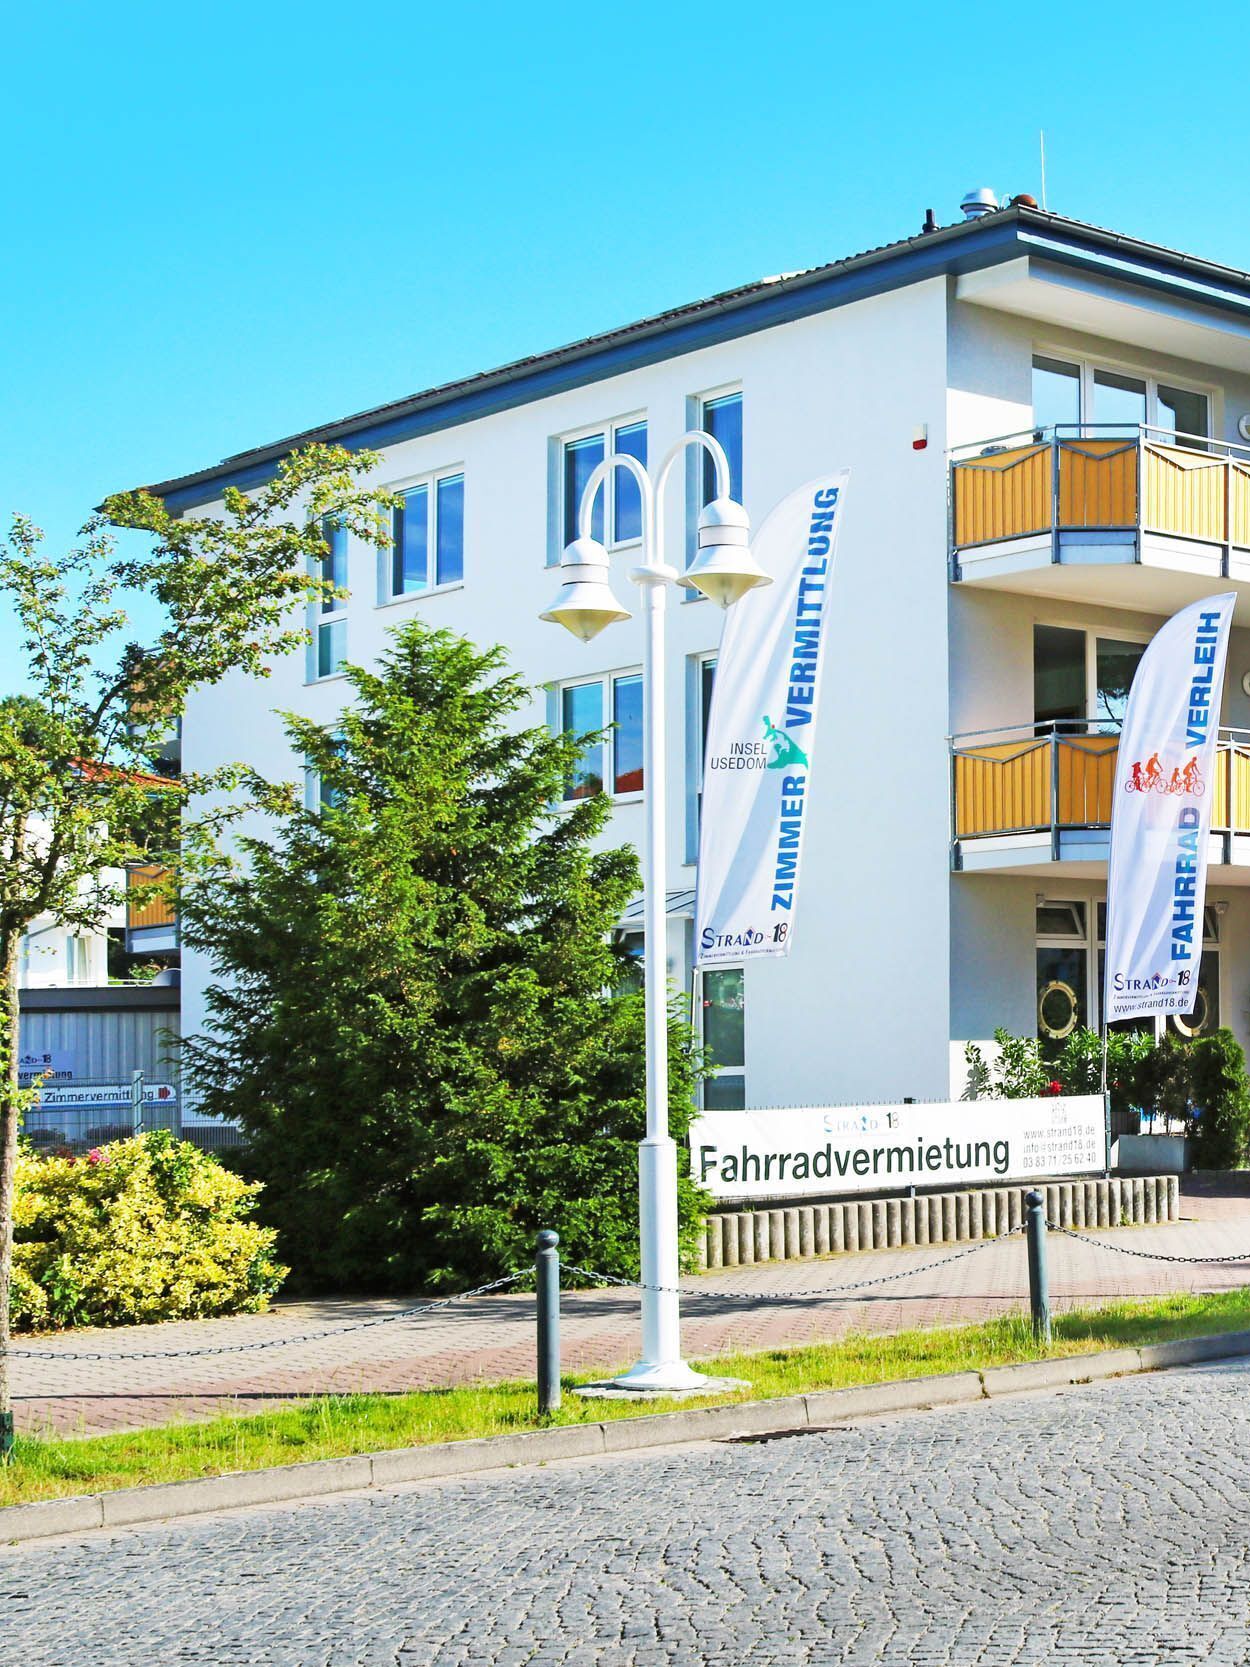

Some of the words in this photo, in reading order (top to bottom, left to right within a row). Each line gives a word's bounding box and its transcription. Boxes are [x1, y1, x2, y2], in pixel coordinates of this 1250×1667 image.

[785, 487, 839, 729] VERMITTLUNG
[1185, 612, 1221, 749] VERLEIH
[710, 757, 767, 770] USEDOM
[730, 743, 768, 755] INSEL
[771, 776, 806, 911] ZIMMER
[1171, 807, 1201, 961] FAHRRAD
[1113, 998, 1189, 1013] www.strand18.de
[44, 1089, 154, 1103] Zimmervermittlng
[1023, 1125, 1096, 1140] www.strand18.de
[700, 1137, 1010, 1183] Fahrradvermietung
